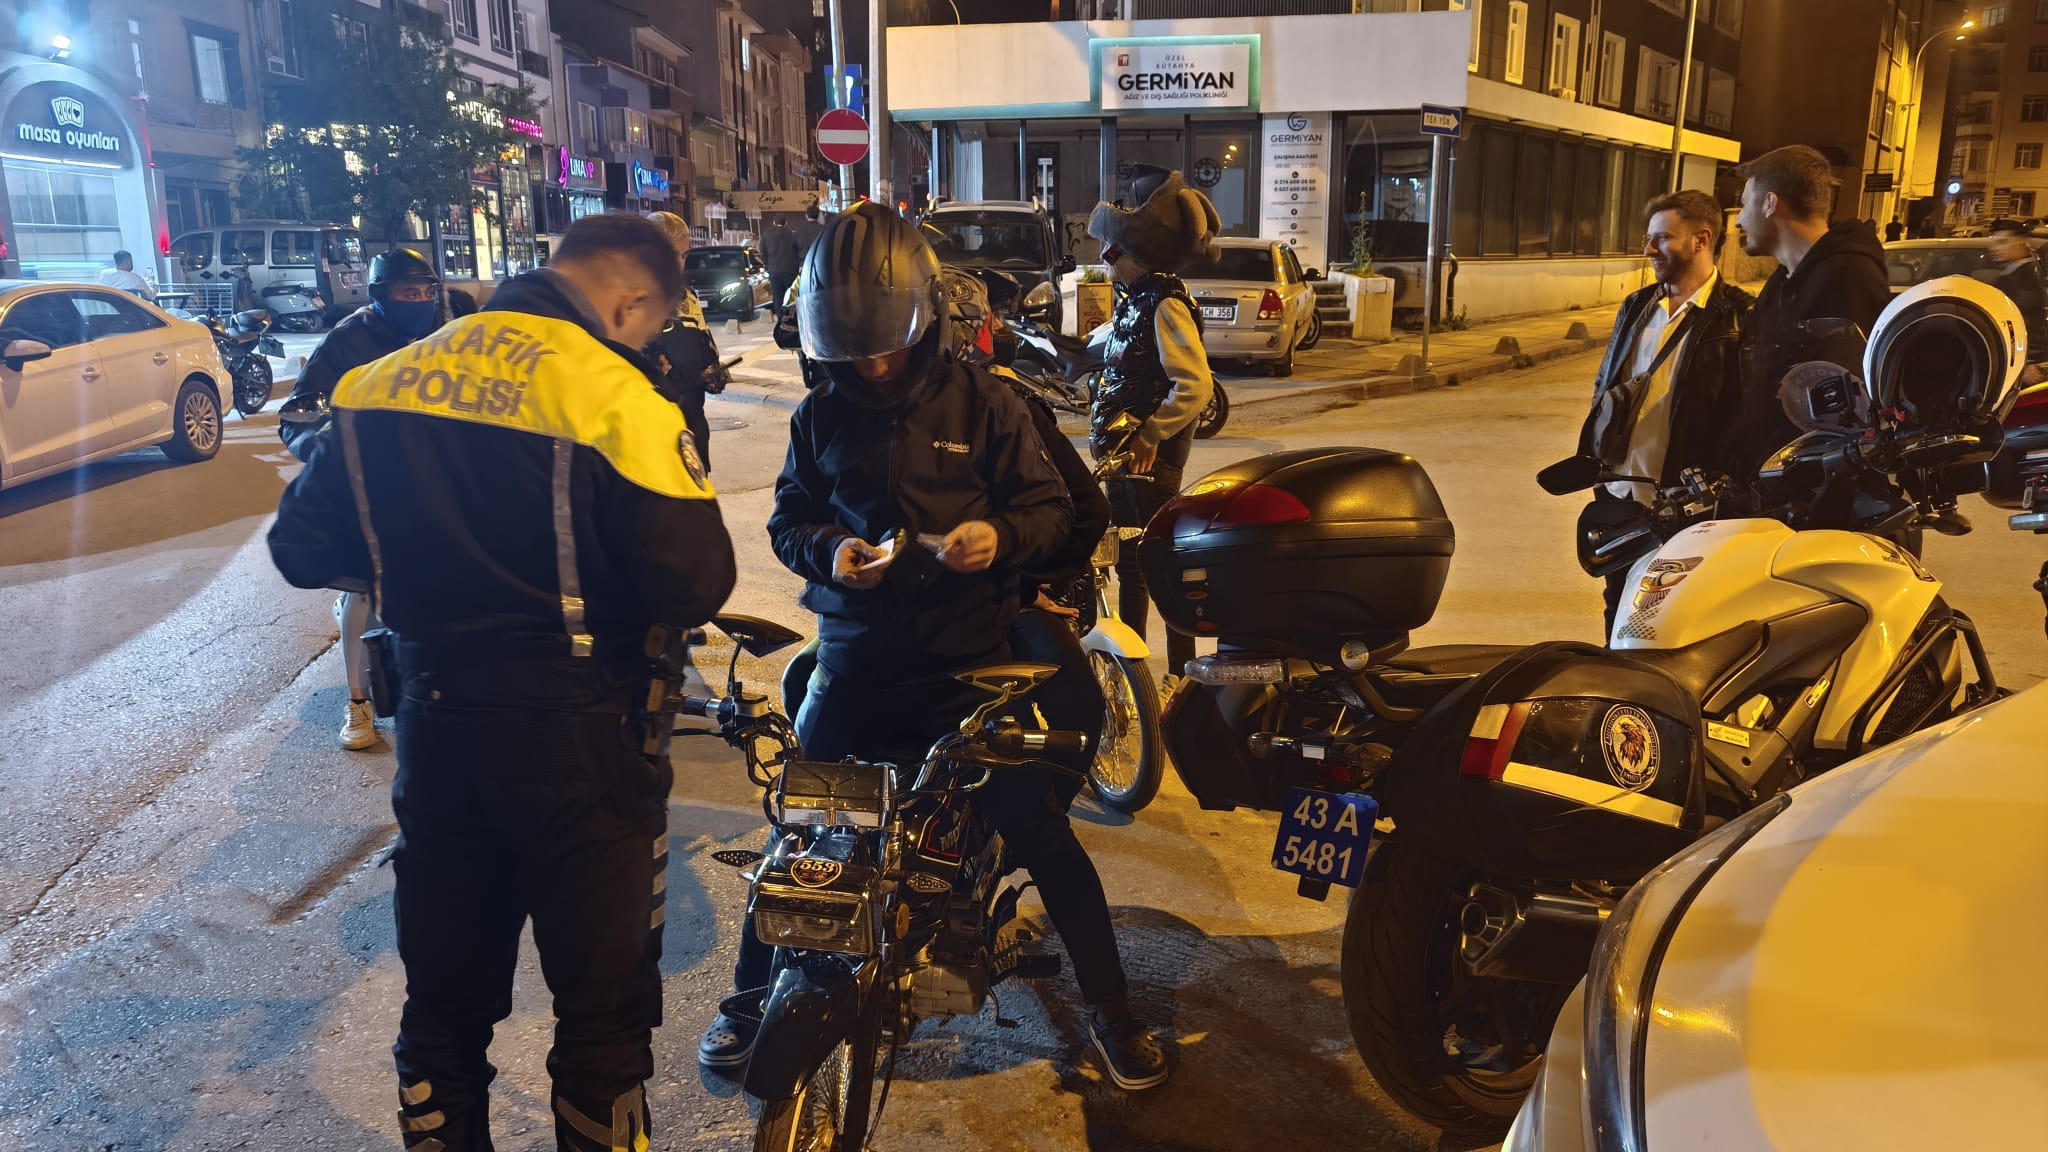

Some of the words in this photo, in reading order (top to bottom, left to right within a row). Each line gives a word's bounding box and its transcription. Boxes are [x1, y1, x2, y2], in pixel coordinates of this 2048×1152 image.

[1165, 54, 1186, 62] ÖZEL
[1427, 115, 1437, 124] TEK
[1439, 116, 1450, 126] YÖN
[18, 123, 61, 144] masa
[66, 130, 120, 151] oyunları
[1217, 307, 1231, 318] 356
[1293, 795, 1329, 830] 43
[1333, 803, 1358, 836] A
[1282, 835, 1353, 879] 5481
[800, 859, 836, 873] 553
